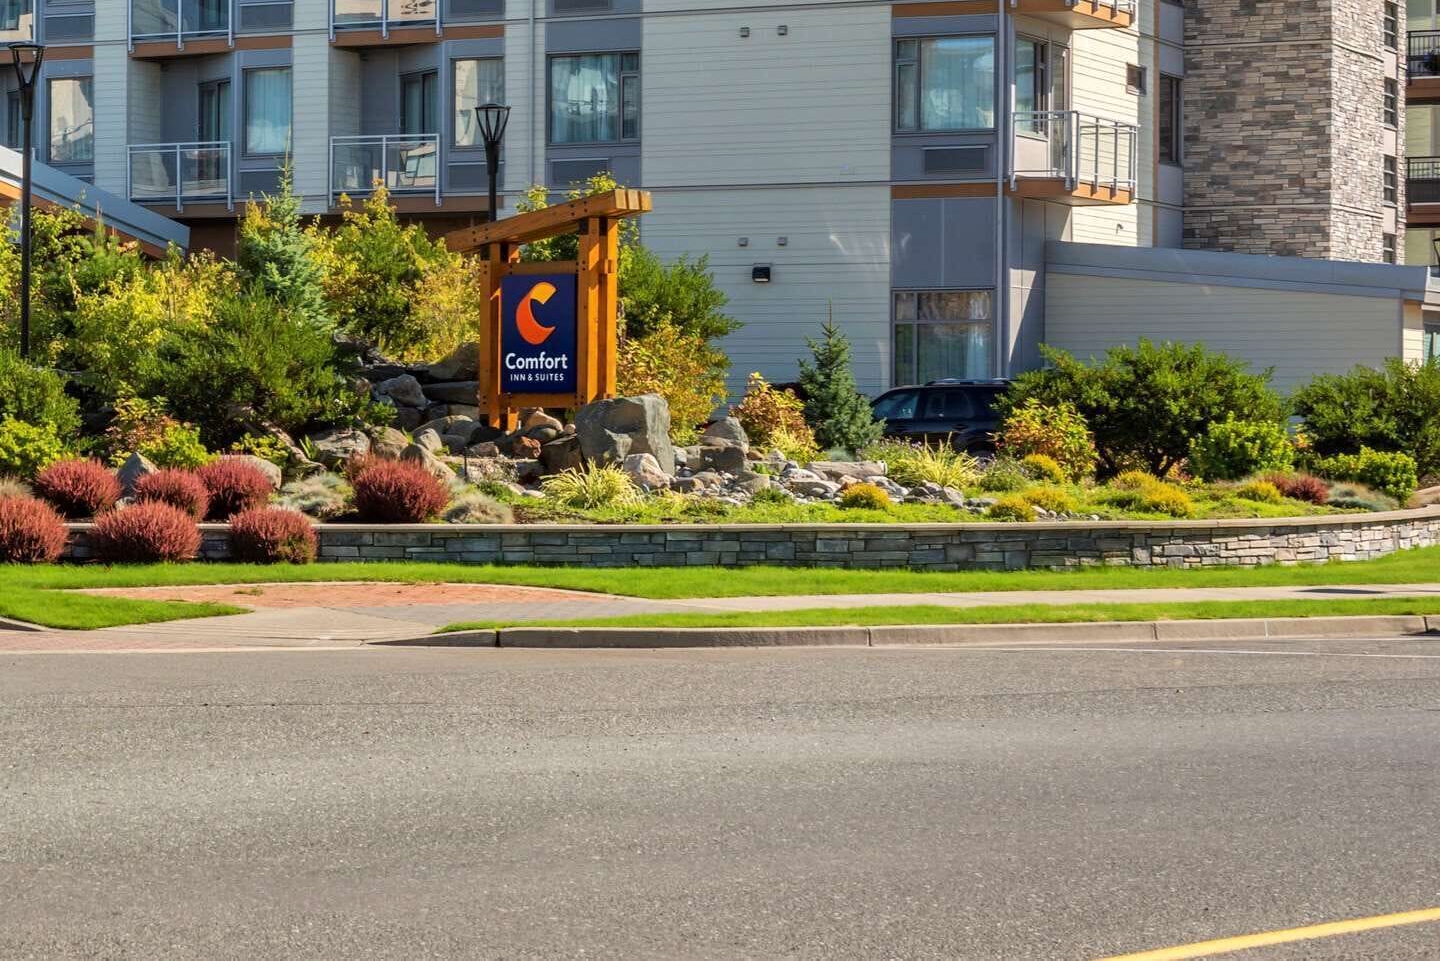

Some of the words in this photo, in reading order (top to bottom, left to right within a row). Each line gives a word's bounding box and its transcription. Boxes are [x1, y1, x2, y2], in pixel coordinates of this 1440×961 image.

[505, 351, 568, 369] Comfort
[510, 373, 526, 381] INN
[527, 373, 533, 381] &
[535, 373, 564, 381] SUITES
